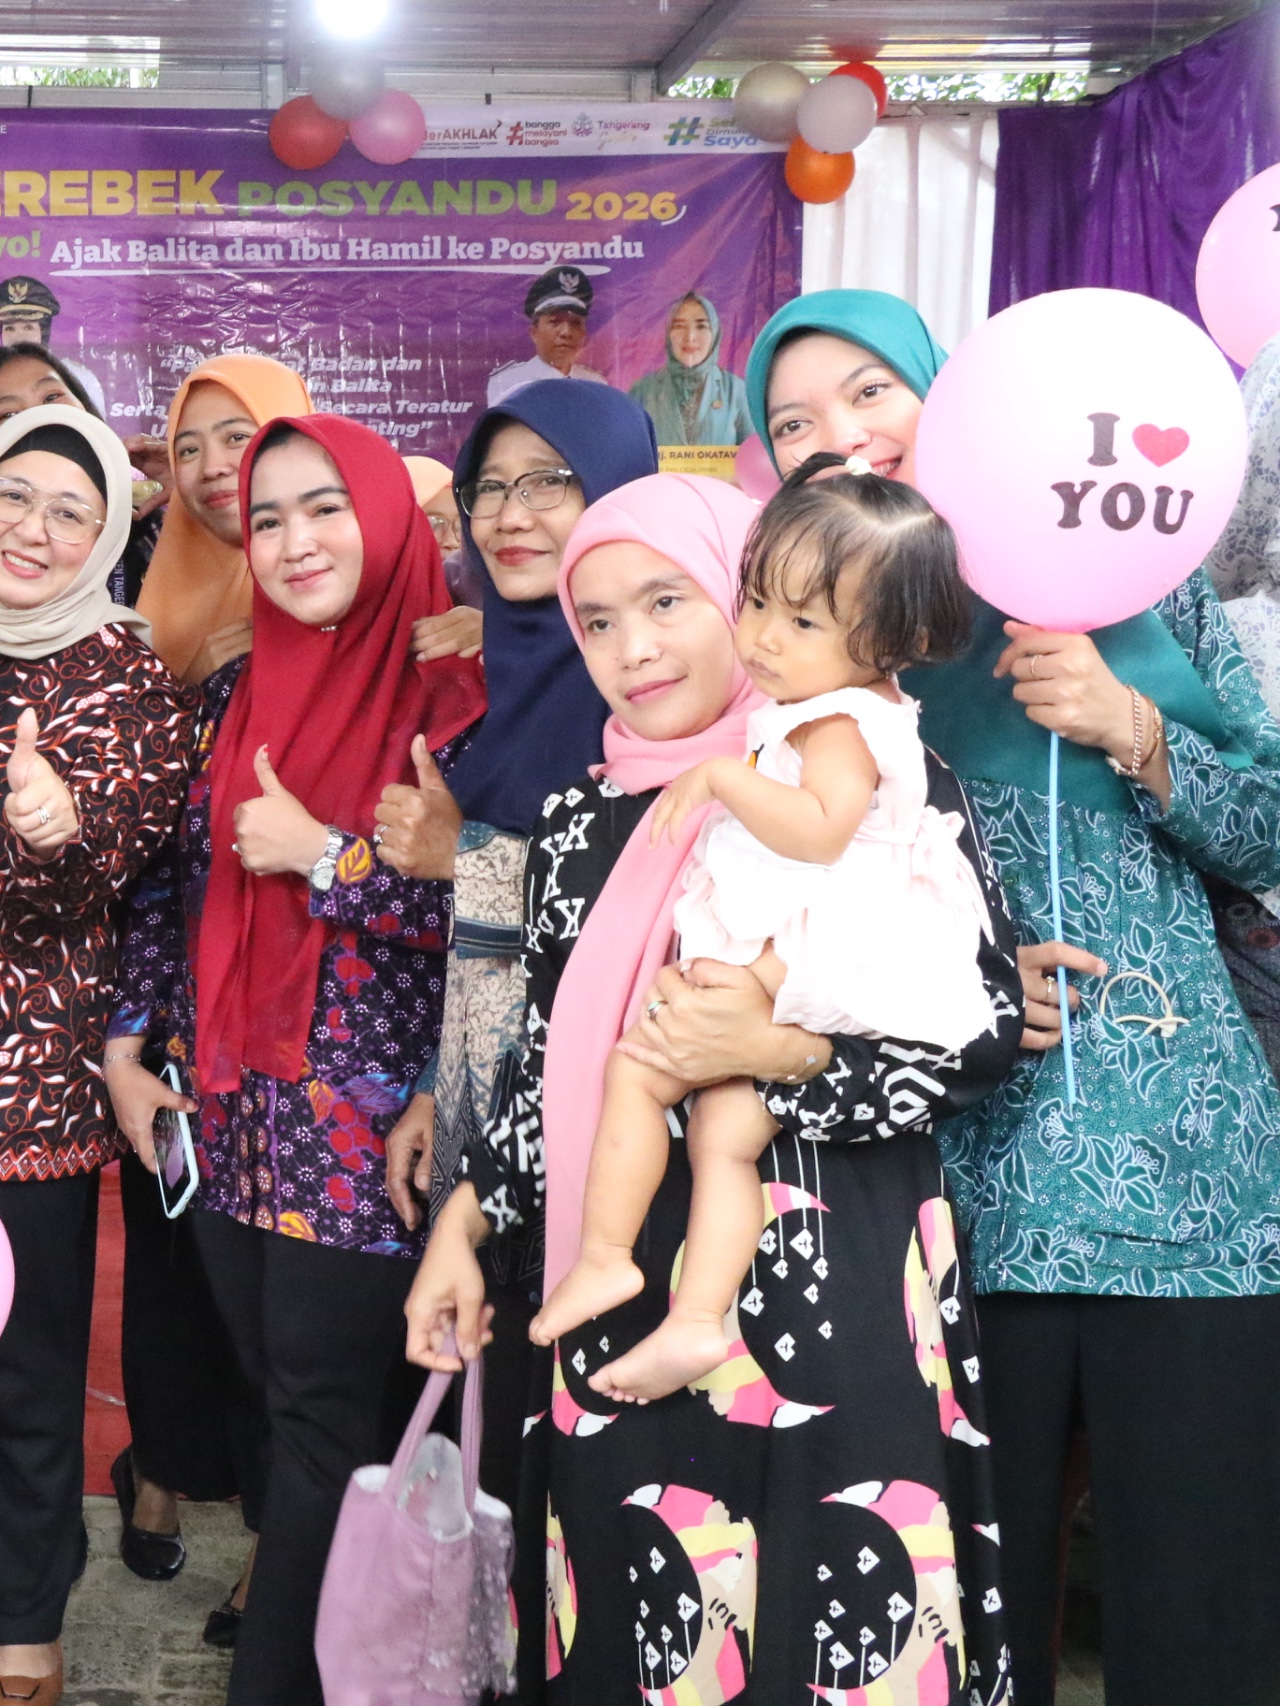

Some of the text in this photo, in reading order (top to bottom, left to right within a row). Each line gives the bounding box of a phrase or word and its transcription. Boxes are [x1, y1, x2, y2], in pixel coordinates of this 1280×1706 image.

[525, 121, 561, 130] bangga
[597, 120, 651, 131] Tangerang
[524, 139, 559, 147] bangsa
[703, 135, 759, 149] Saya
[237, 179, 558, 217] POSYANDU
[565, 191, 678, 220] 2026
[49, 235, 645, 269] Ajak Balita dan Ibu Hamil ke Posyandu
[310, 356, 378, 372] Badan
[383, 356, 422, 371] dan
[330, 378, 393, 393] Balita
[109, 400, 473, 418] Serta Secara Teratur
[366, 420, 434, 438] nting”
[1087, 412, 1120, 467] I
[669, 451, 695, 459] RANI
[697, 451, 738, 459] OKATAV
[1050, 480, 1194, 535] YOU
